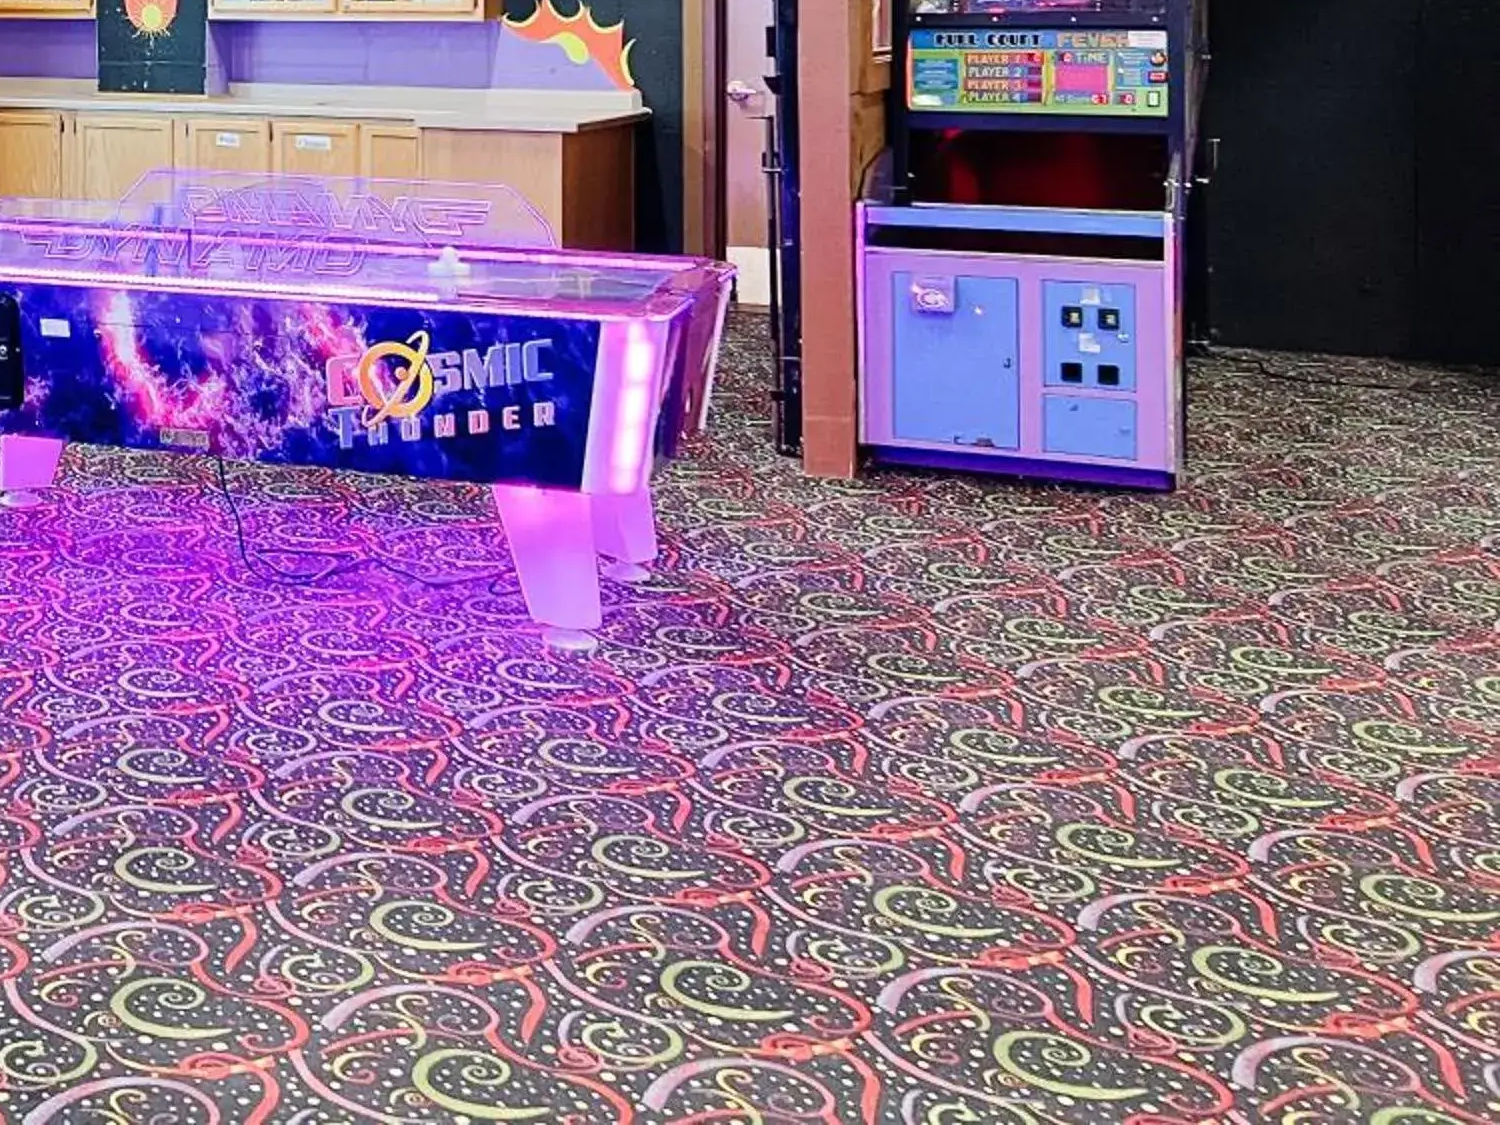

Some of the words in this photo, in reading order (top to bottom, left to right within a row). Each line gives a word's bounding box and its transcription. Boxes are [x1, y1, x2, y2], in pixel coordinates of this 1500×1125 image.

[967, 53, 1009, 64] PLAYER
[968, 66, 1009, 78] PLAYER
[967, 78, 1009, 90] PLAYER
[968, 91, 1009, 102] PLAYER
[22, 221, 366, 275] DYNAMO
[326, 335, 555, 421] COSMIC
[328, 400, 557, 450] THUNDER
